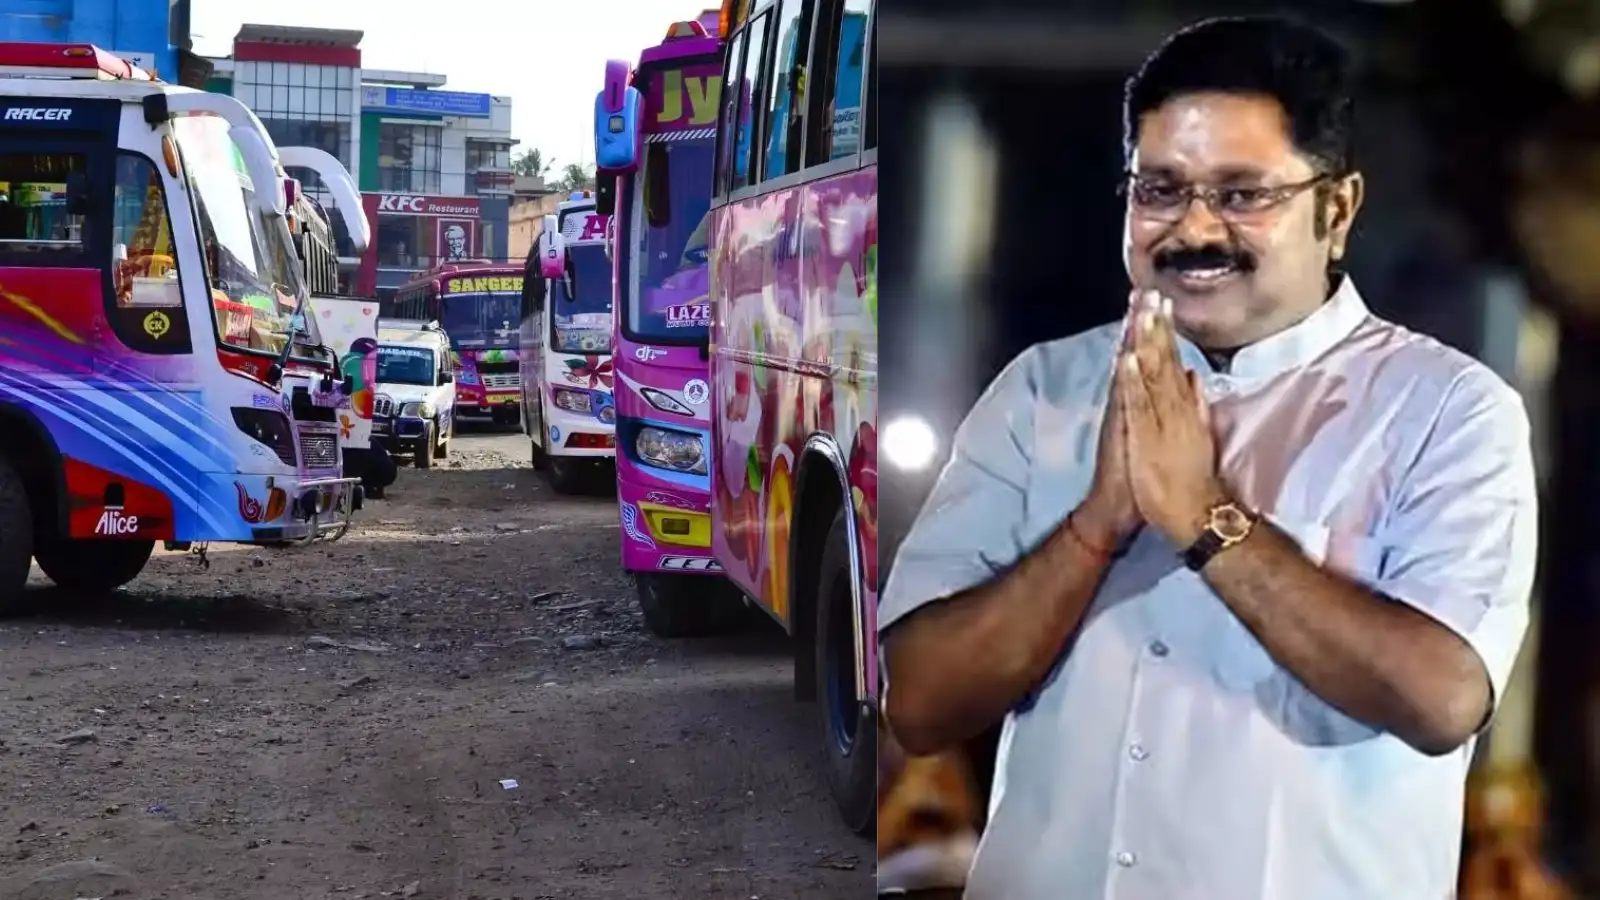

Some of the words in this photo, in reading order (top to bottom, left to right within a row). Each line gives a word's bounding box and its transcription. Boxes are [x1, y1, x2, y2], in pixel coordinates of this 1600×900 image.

[4, 107, 72, 120] RACER
[377, 195, 425, 212] KFC
[428, 203, 479, 214] Restaurant
[94, 511, 138, 535] Alice
